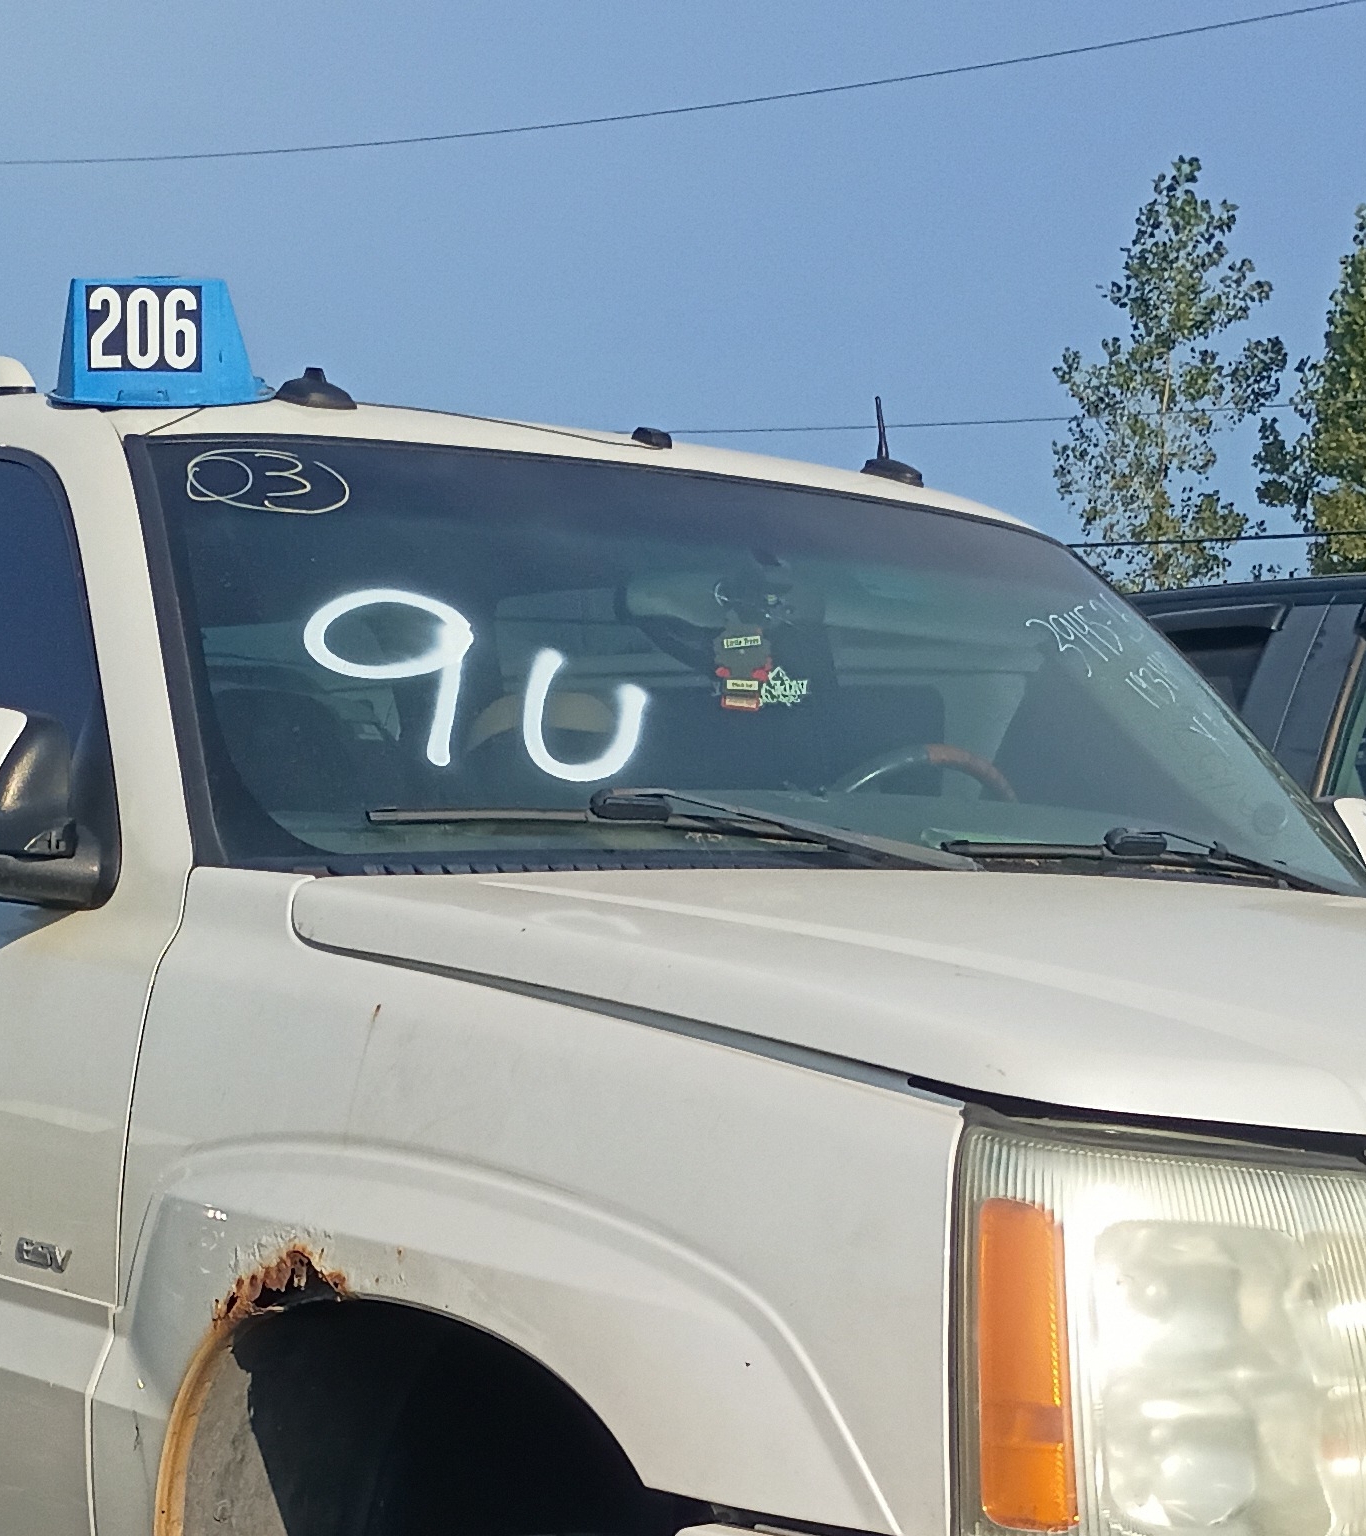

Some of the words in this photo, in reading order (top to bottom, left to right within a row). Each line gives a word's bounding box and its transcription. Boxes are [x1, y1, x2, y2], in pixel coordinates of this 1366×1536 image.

[88, 286, 199, 369] 206
[188, 452, 312, 501] 03
[15, 1237, 72, 1274] ESV
